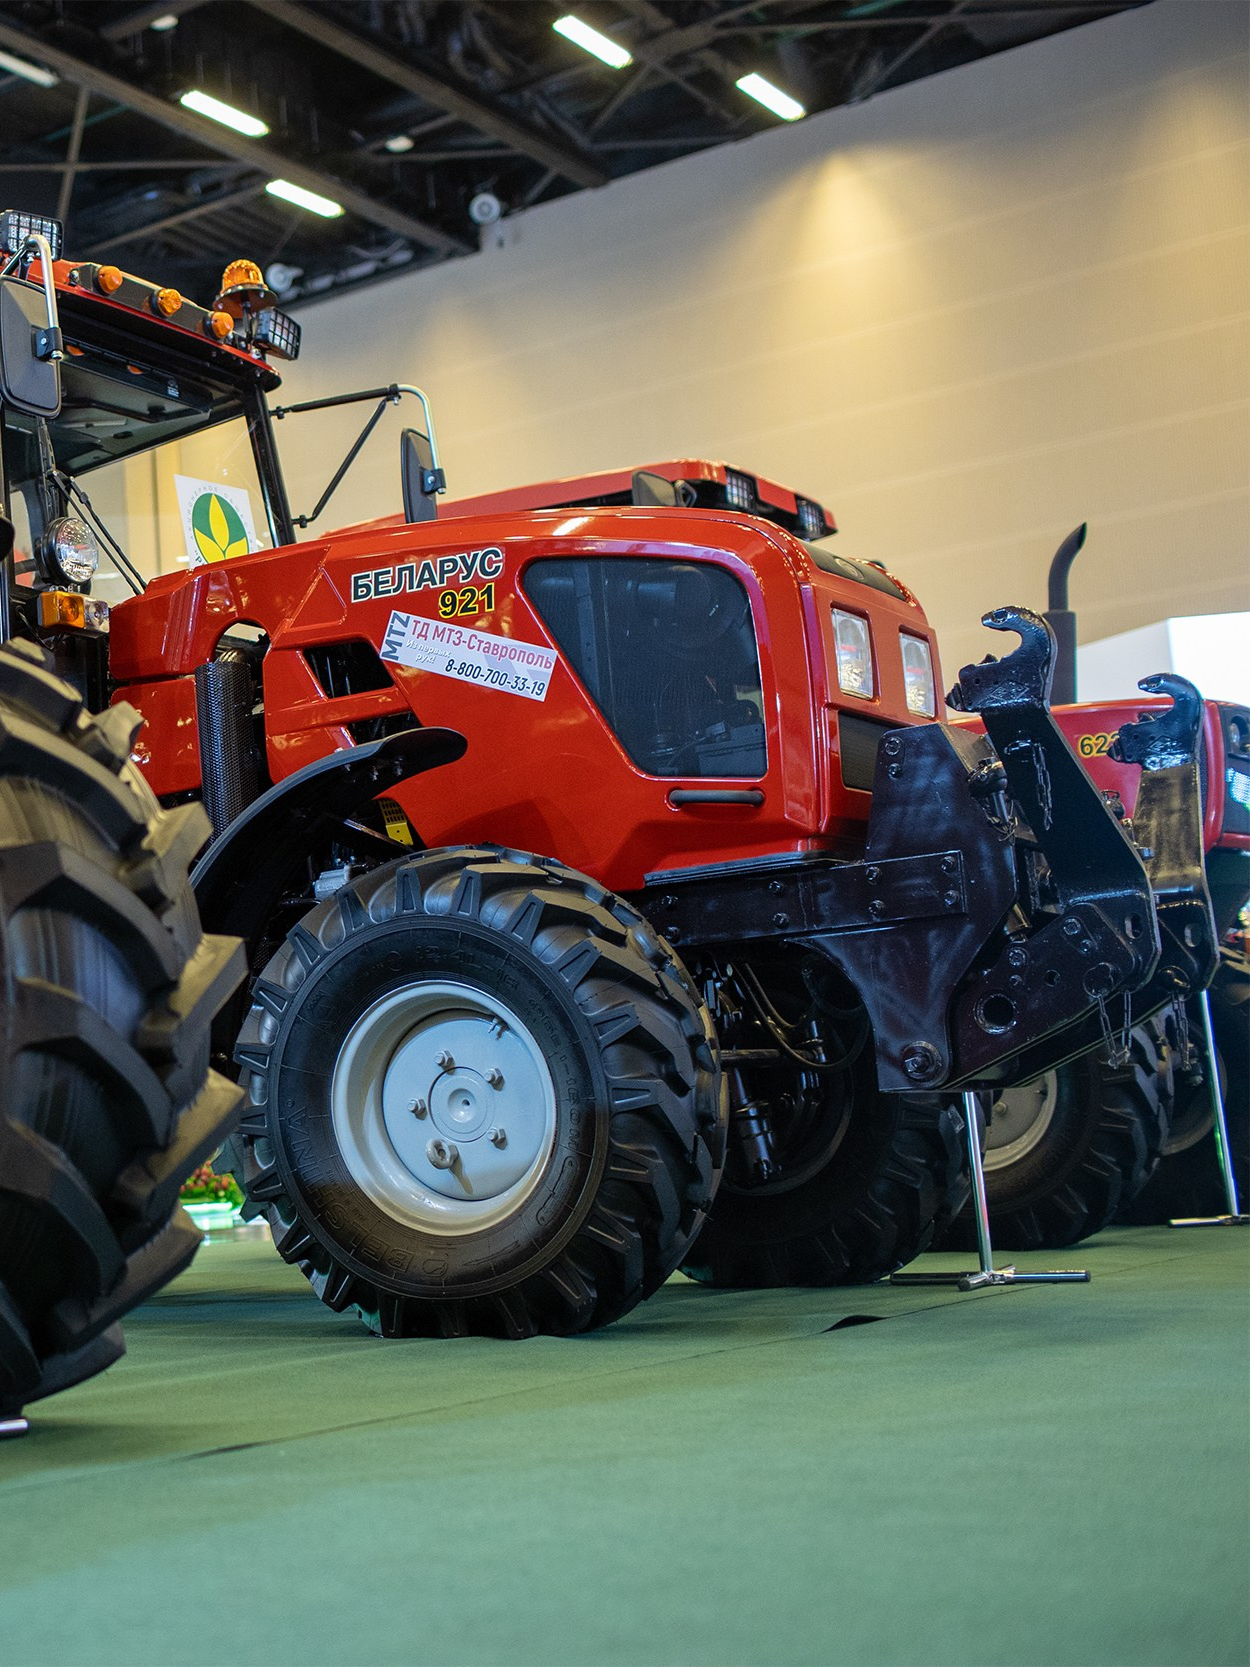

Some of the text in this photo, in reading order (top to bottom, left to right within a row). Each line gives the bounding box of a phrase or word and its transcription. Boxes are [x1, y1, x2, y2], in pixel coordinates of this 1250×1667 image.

[351, 547, 503, 603] БЕЛАРУС
[439, 582, 495, 618] 921
[381, 612, 411, 661] MTZ
[406, 639, 451, 658] Из первых
[412, 619, 553, 670] ТД МТЗ-Ставрополь
[415, 651, 436, 664] рук!
[445, 658, 546, 697] 8-800-700-33-19
[1078, 731, 1119, 758] 62
